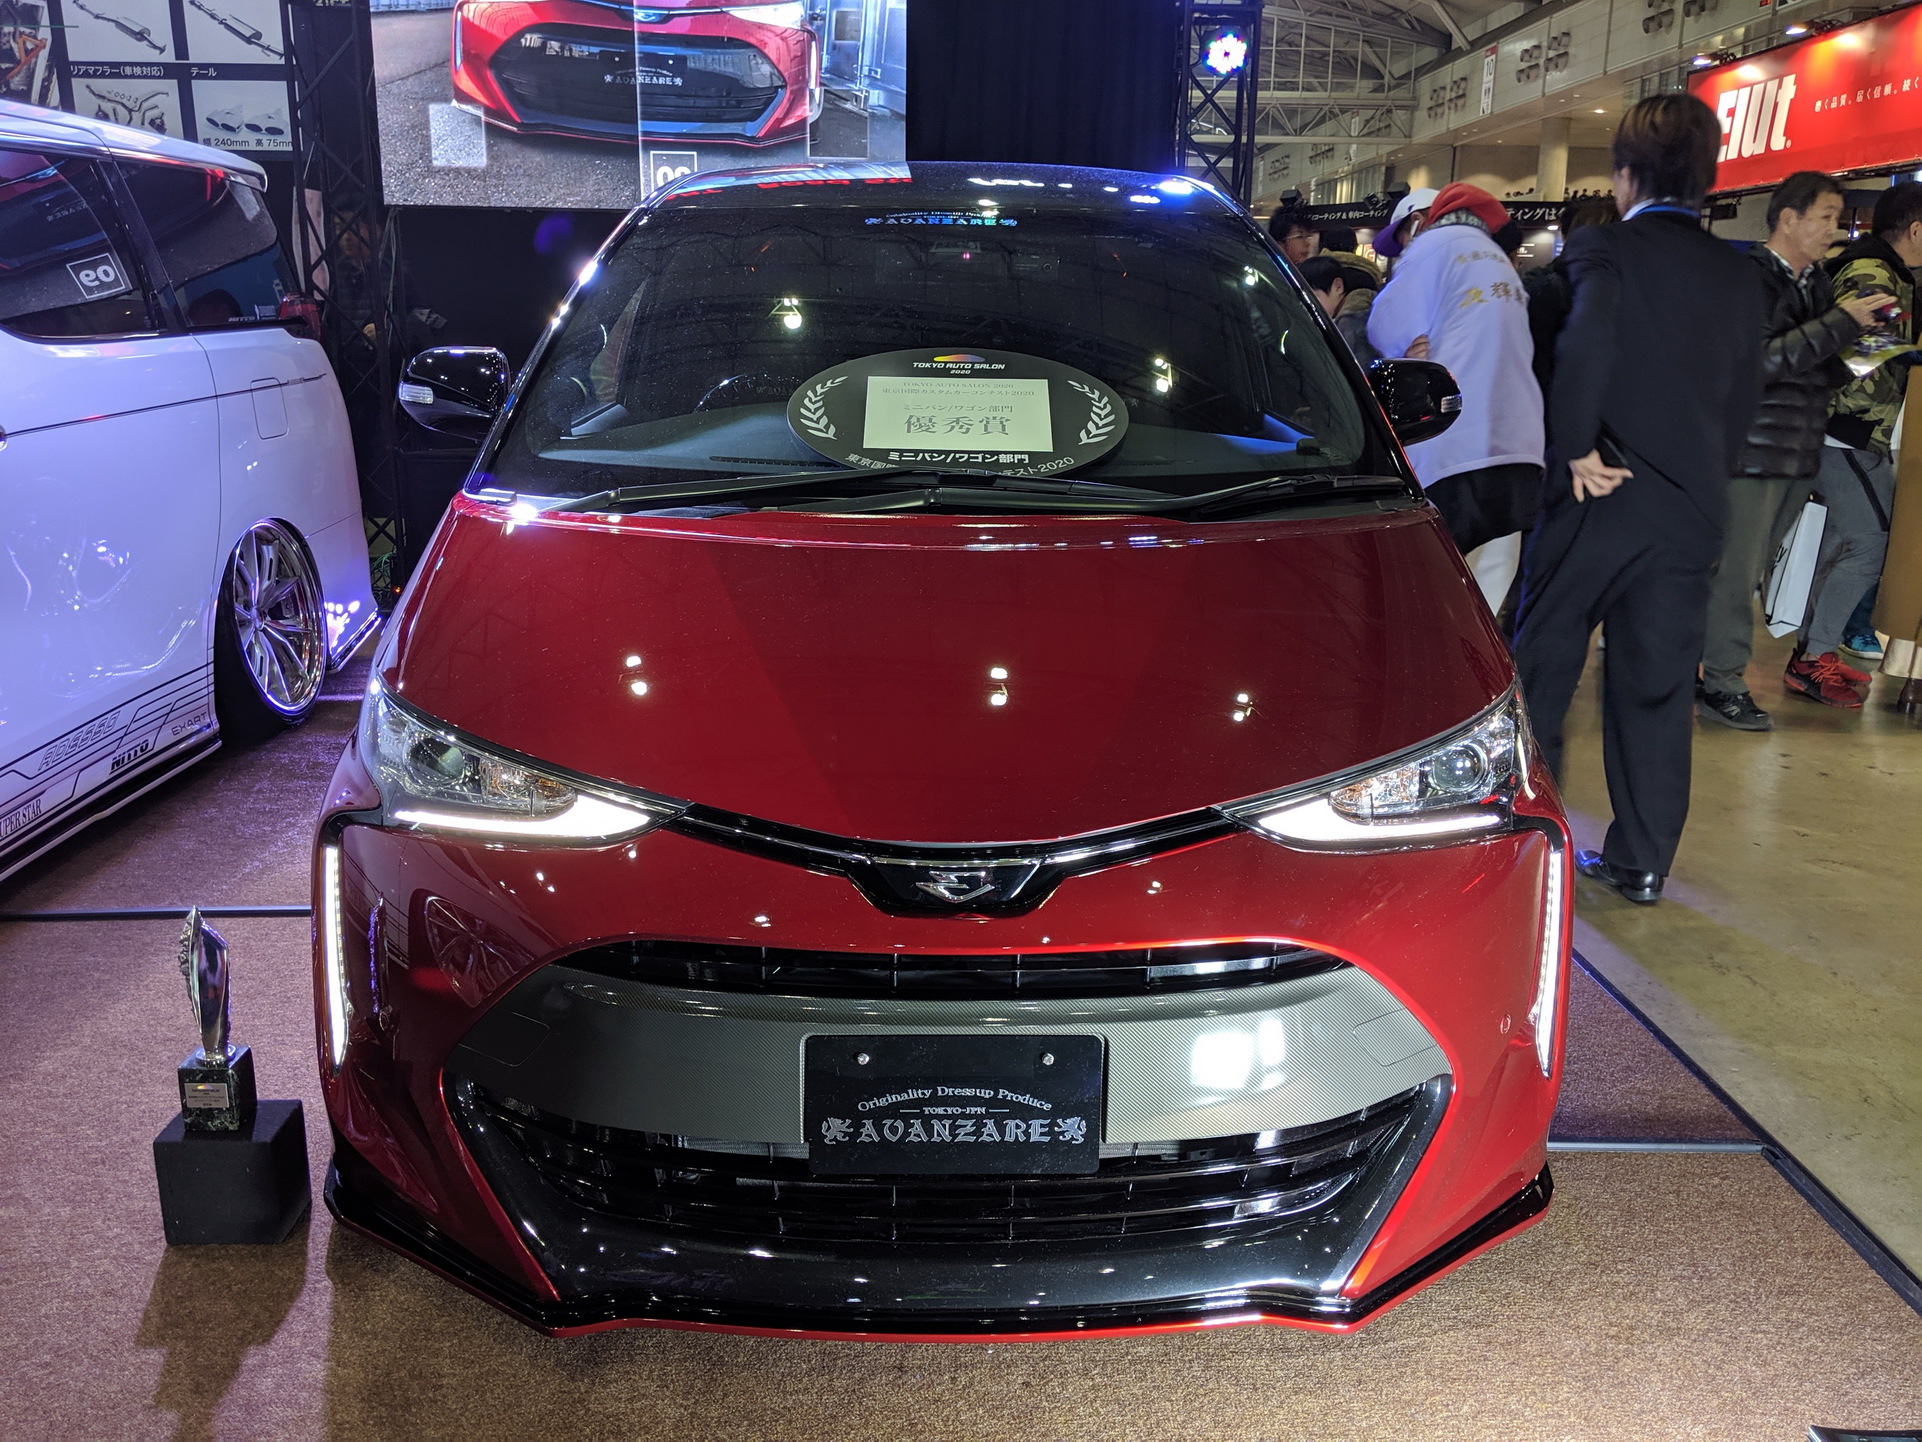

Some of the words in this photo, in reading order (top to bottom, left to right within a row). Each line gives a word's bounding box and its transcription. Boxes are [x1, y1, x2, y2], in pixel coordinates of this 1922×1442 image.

[190, 67, 217, 77] テール
[214, 138, 250, 147] 240mm
[255, 138, 264, 148] 高
[912, 361, 945, 369] TOKYO
[945, 362, 972, 370] AUTO
[903, 403, 1013, 413] ミニバン/ワゴン部門
[904, 414, 1013, 436] 優秀賞
[887, 450, 1030, 464] ミニバン/ワゴン部門
[171, 711, 208, 737] EXART
[110, 738, 150, 772] NITTO
[22, 798, 42, 824] STAR
[858, 1087, 933, 1112] Originality
[997, 1088, 1053, 1112] Produce
[922, 1106, 987, 1116] TOKYO-JPN
[856, 1118, 1052, 1144] AVANZARE
